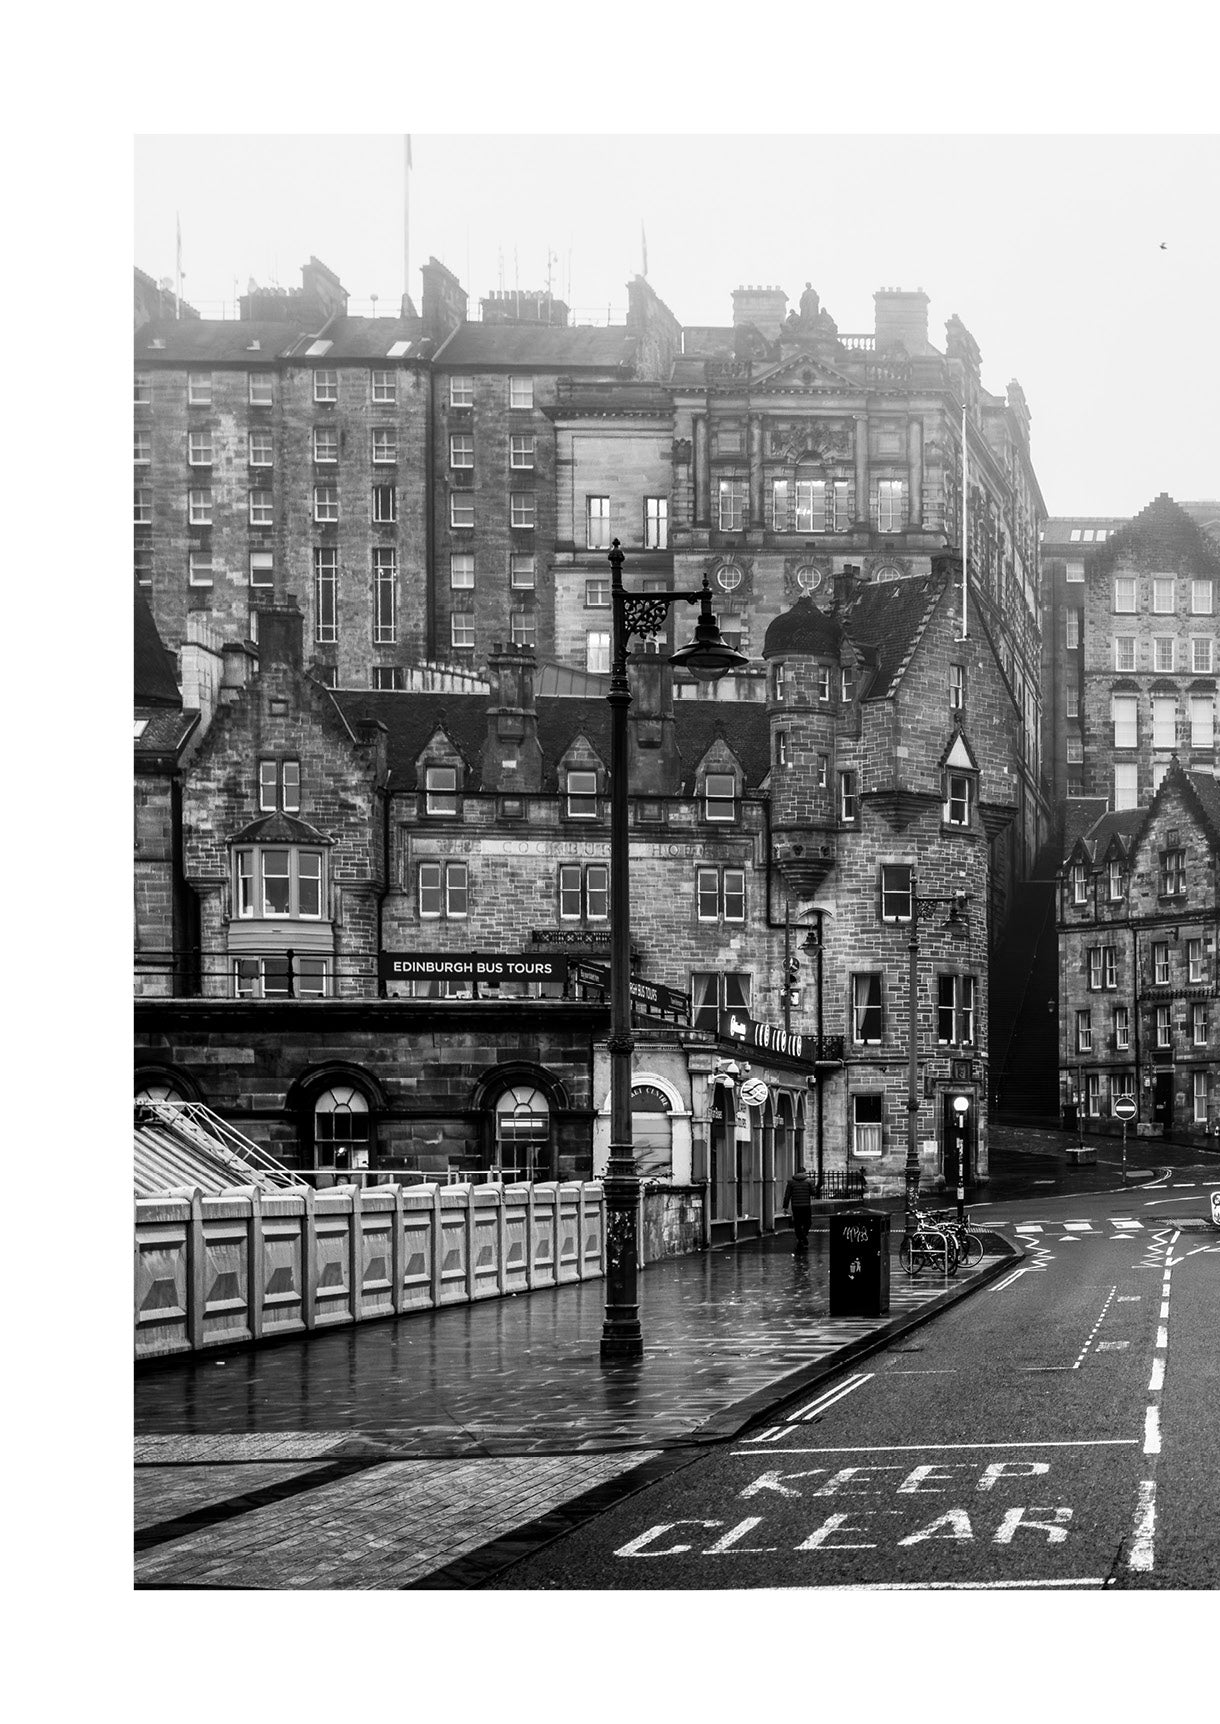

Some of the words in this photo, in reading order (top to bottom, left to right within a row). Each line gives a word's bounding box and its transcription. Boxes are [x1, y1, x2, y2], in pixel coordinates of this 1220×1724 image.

[502, 841, 612, 855] COCKBUR
[393, 961, 473, 973] EDINBURGH
[476, 962, 503, 973] BUS
[506, 962, 553, 974] TOURS
[737, 1462, 1050, 1499] KEEP
[612, 1506, 1074, 1557] CLEAR
